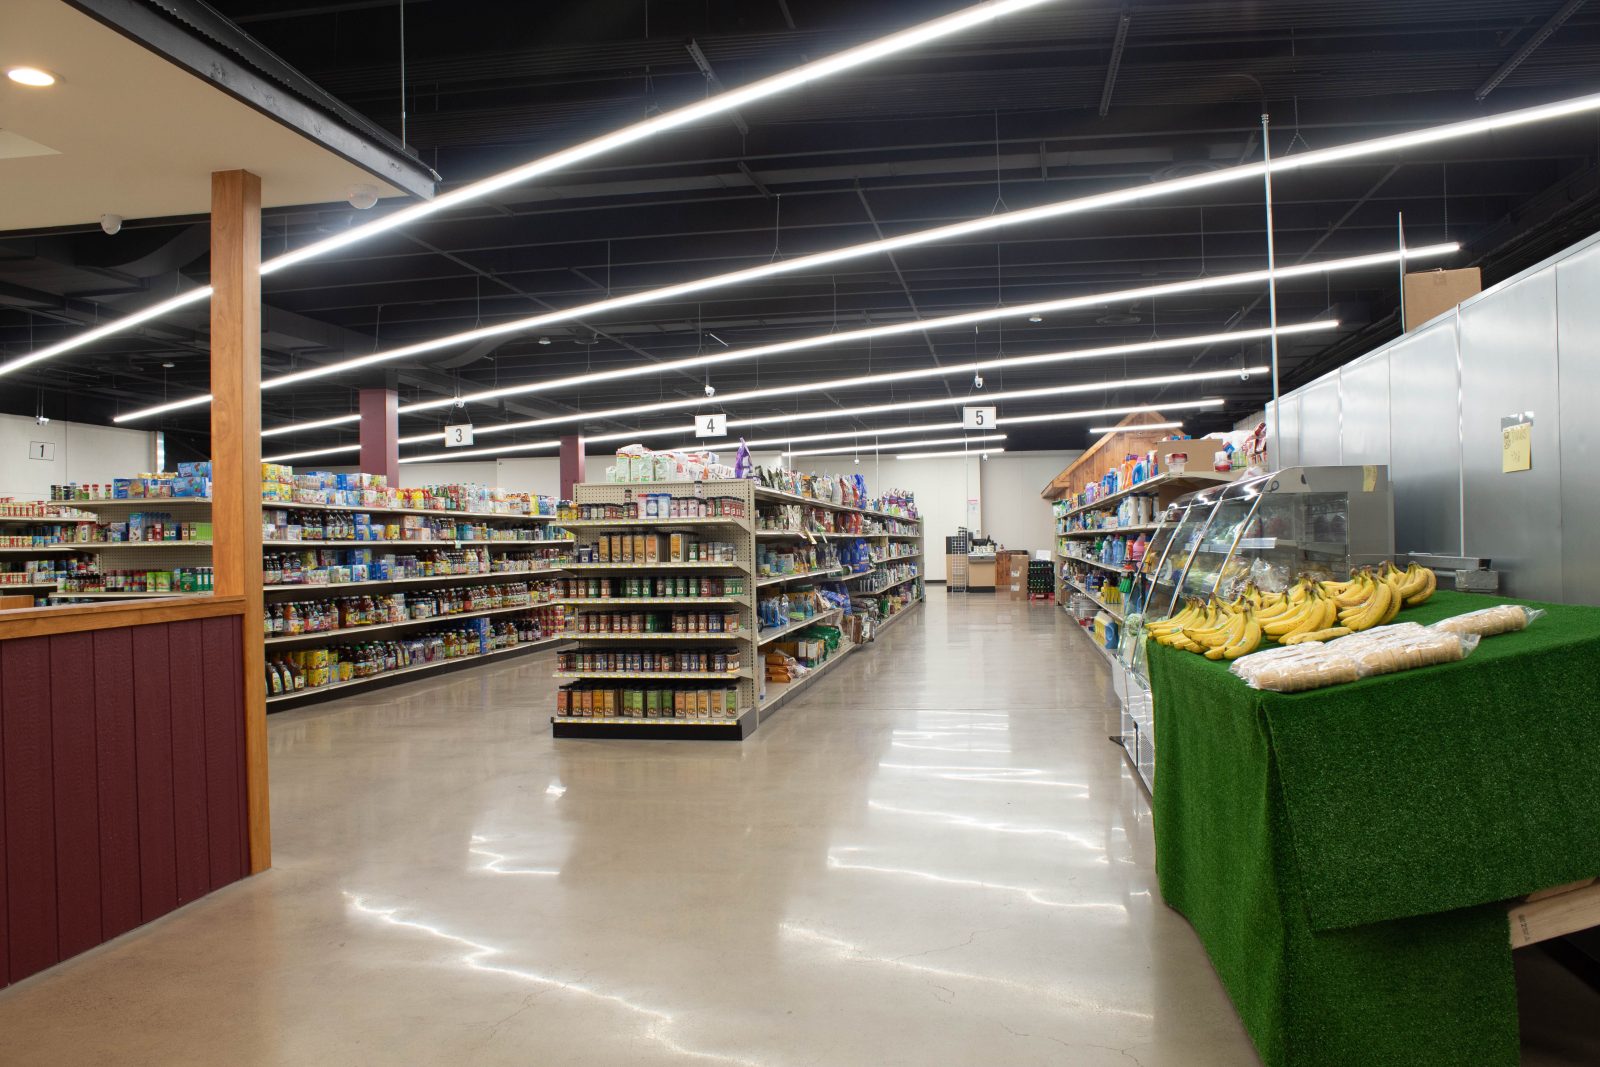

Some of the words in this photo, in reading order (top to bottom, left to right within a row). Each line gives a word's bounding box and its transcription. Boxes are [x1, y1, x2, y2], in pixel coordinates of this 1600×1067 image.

[976, 410, 983, 425] 5
[707, 418, 715, 432] 4
[455, 428, 463, 443] 3
[39, 444, 44, 458] 1
